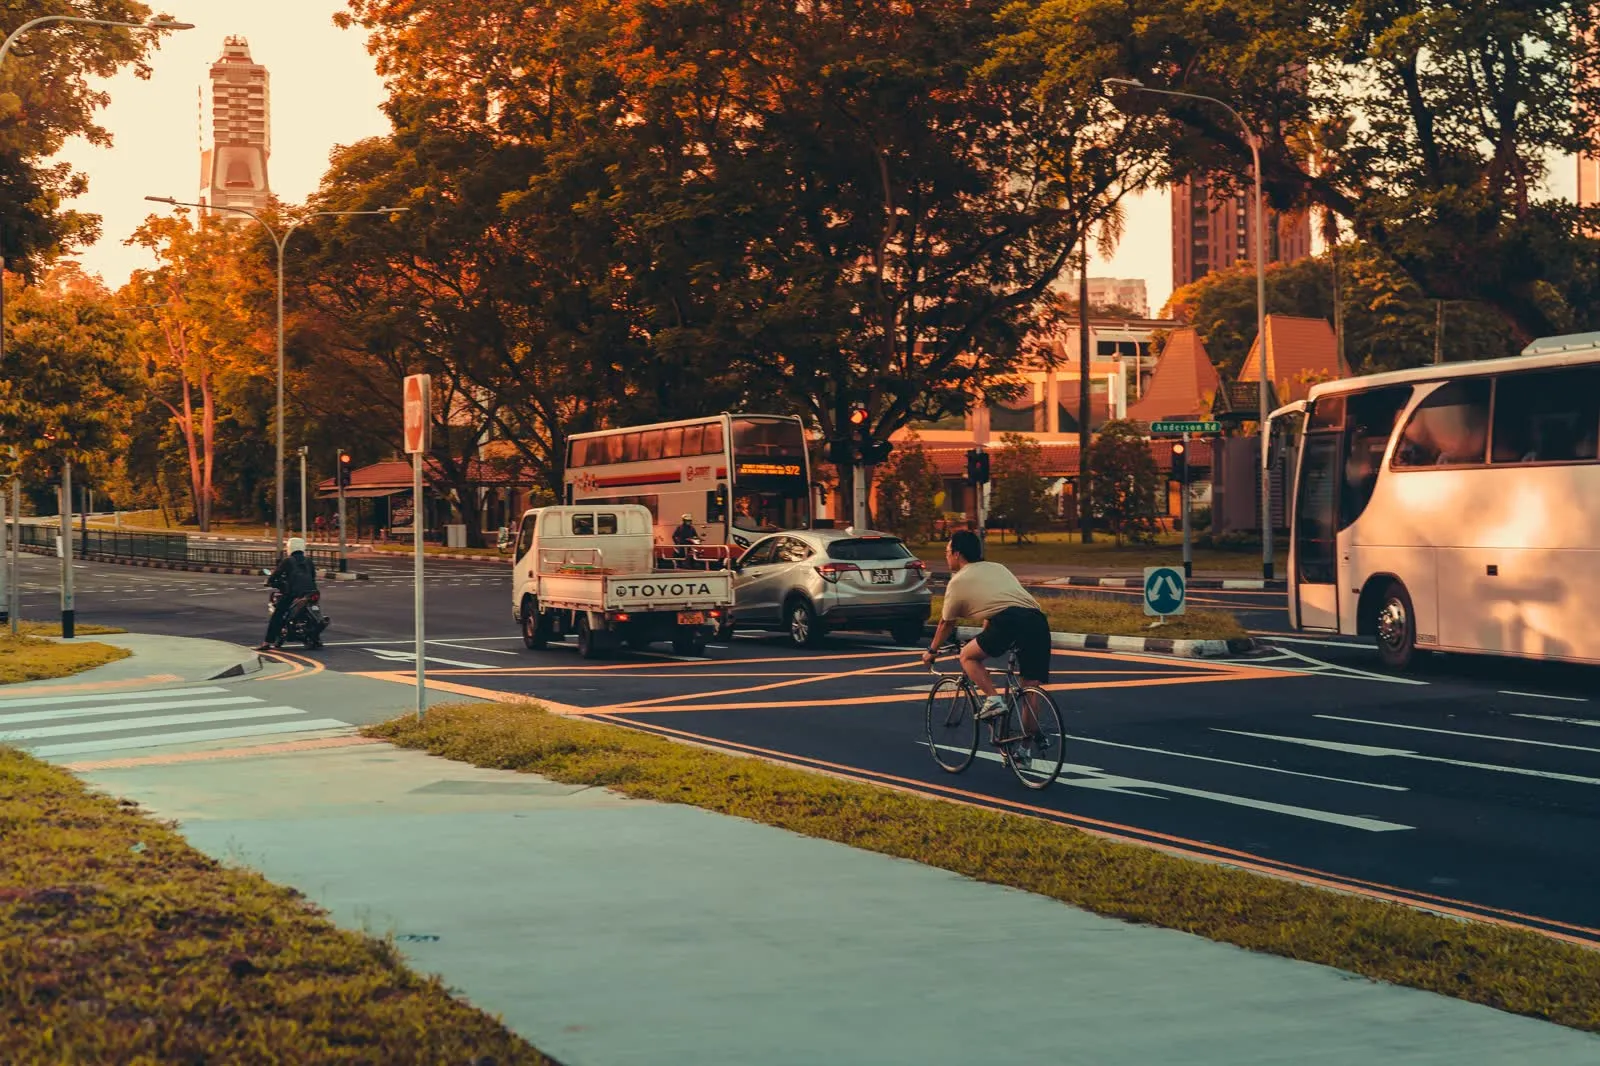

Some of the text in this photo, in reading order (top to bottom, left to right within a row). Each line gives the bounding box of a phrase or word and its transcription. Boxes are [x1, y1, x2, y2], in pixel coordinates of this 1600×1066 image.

[1156, 422, 1217, 431] Anderson Rd
[785, 465, 801, 476] 972
[628, 583, 711, 597] TOYOTA
